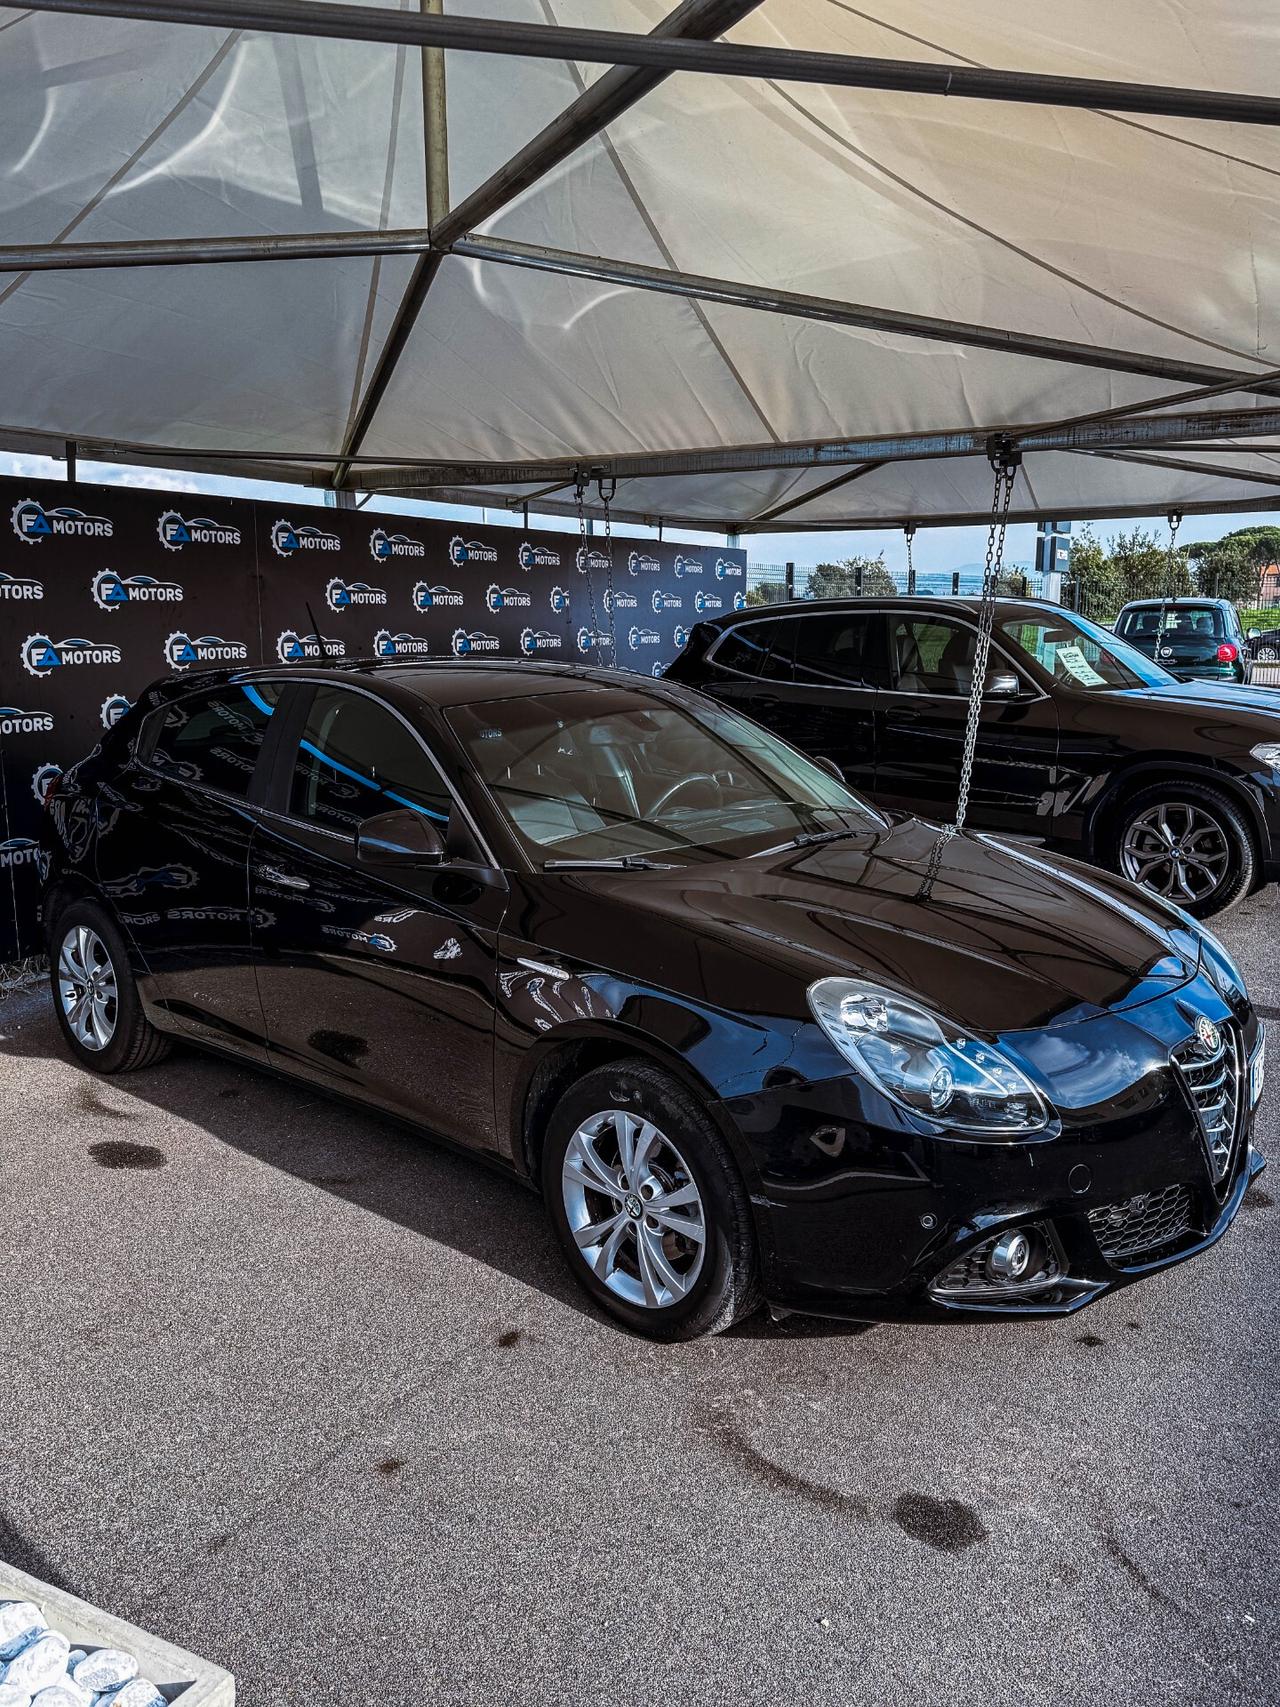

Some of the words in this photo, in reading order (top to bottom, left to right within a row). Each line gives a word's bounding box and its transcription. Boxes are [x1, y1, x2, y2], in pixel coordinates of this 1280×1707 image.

[22, 513, 52, 533] FA
[52, 519, 113, 537] MOTORS
[165, 523, 191, 542] FA
[191, 528, 241, 545] MOTORS
[278, 532, 300, 549] FA
[299, 536, 341, 551] MOTORS
[375, 540, 392, 556] FA
[392, 543, 425, 557] MOTORS
[453, 546, 468, 560] FA
[468, 548, 498, 562] MOTORS
[534, 555, 561, 566] MOTORS
[640, 562, 661, 572] MOTORS
[0, 584, 44, 600] TORS
[101, 583, 129, 601] FA
[128, 587, 184, 601] MOTORS
[331, 588, 351, 604] FA
[350, 592, 387, 605] MOTORS
[416, 591, 433, 605] FA
[432, 594, 464, 605] MOTORS
[490, 593, 504, 607] FA
[503, 595, 531, 607] MOTORS
[616, 598, 638, 608] MOTORS
[379, 640, 396, 655] FA
[395, 641, 428, 654] MOTORS
[456, 638, 470, 652] FA
[470, 640, 500, 651] MOTORS
[536, 638, 562, 648] MOTORS
[640, 635, 660, 644] MOTORS
[31, 646, 62, 667] FA
[61, 649, 122, 665] MOTORS
[172, 643, 198, 661] FA
[197, 645, 248, 661] MOTORS
[283, 642, 305, 658] FA
[304, 644, 346, 657] MOORS
[0, 716, 54, 735] OTORS
